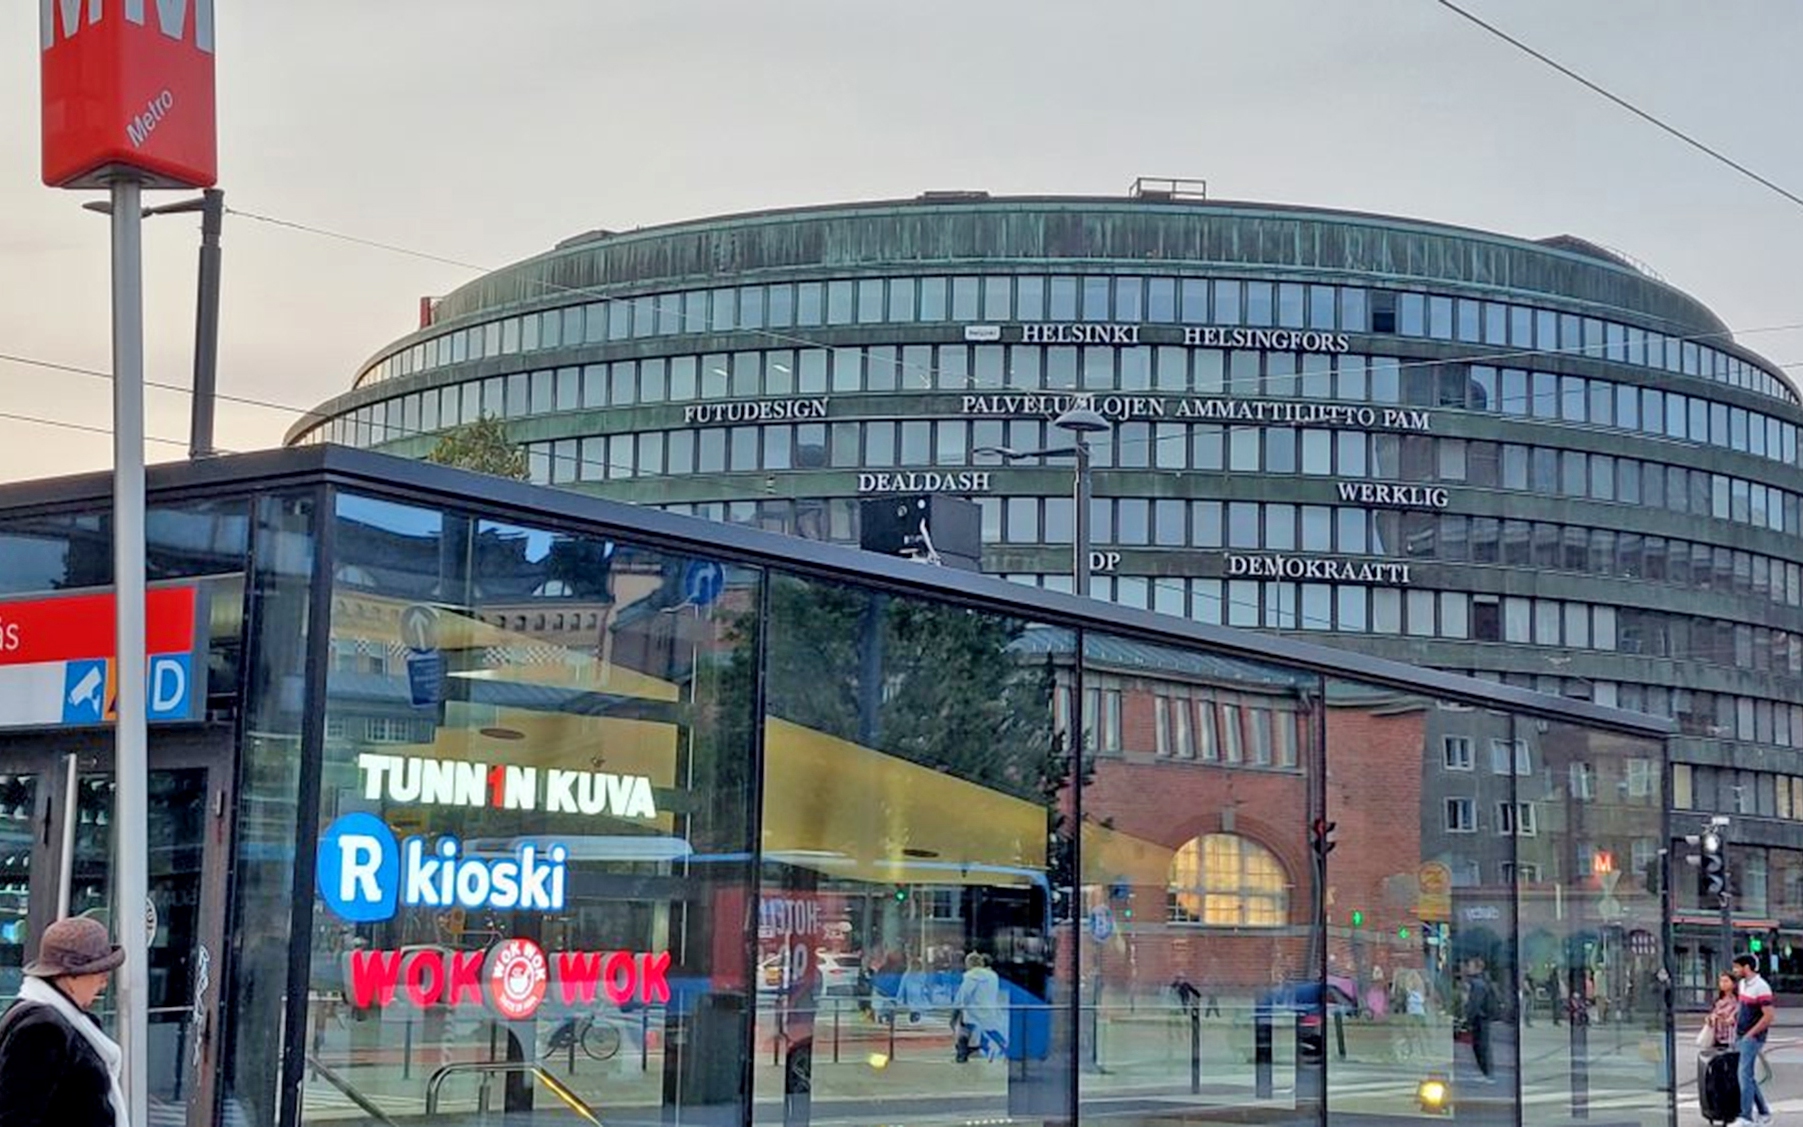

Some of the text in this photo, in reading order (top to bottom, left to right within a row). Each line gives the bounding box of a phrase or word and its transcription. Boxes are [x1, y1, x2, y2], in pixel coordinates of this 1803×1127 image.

[126, 90, 173, 147] Metro
[1022, 324, 1350, 353] HELSINKI HELSINGFORS
[683, 399, 829, 424] FUTUDESIGN
[962, 394, 1165, 421] PALVELULOJEN
[1382, 409, 1431, 431] PAM
[858, 471, 991, 493] DEALDASH
[1337, 482, 1449, 508] WERKLIG
[1229, 555, 1411, 584] DEMOKRAATTI
[152, 660, 185, 711] D
[546, 768, 657, 818] KUVA
[338, 834, 565, 909] R kioski
[350, 949, 672, 1008] WOK WOK
[492, 941, 521, 979] WOK
